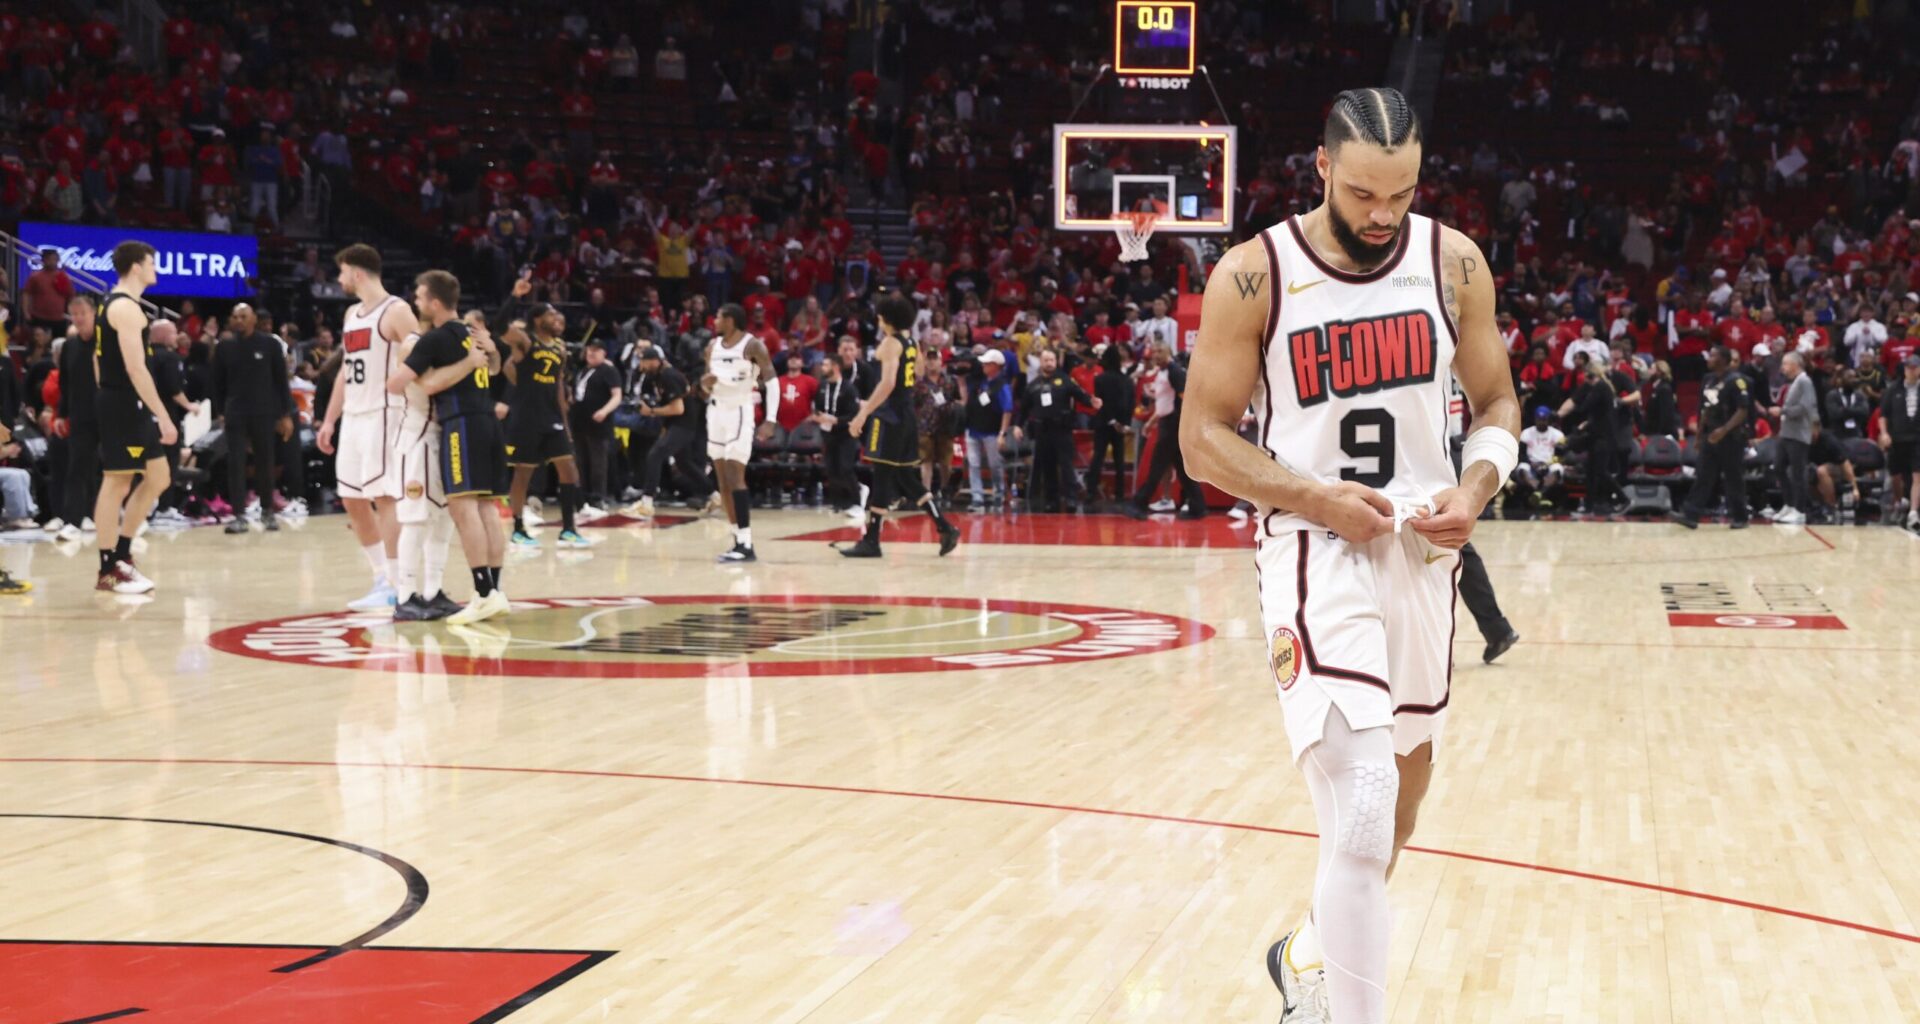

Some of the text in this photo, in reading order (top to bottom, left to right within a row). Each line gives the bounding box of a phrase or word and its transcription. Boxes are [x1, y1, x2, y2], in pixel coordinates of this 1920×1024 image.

[1138, 6, 1174, 30] 0.0
[1138, 77, 1190, 89] TISSOT
[154, 250, 246, 278] ULTRA
[1460, 256, 1476, 286] P
[1232, 271, 1268, 300] W
[543, 359, 553, 375] 7
[1340, 408, 1395, 489] 9
